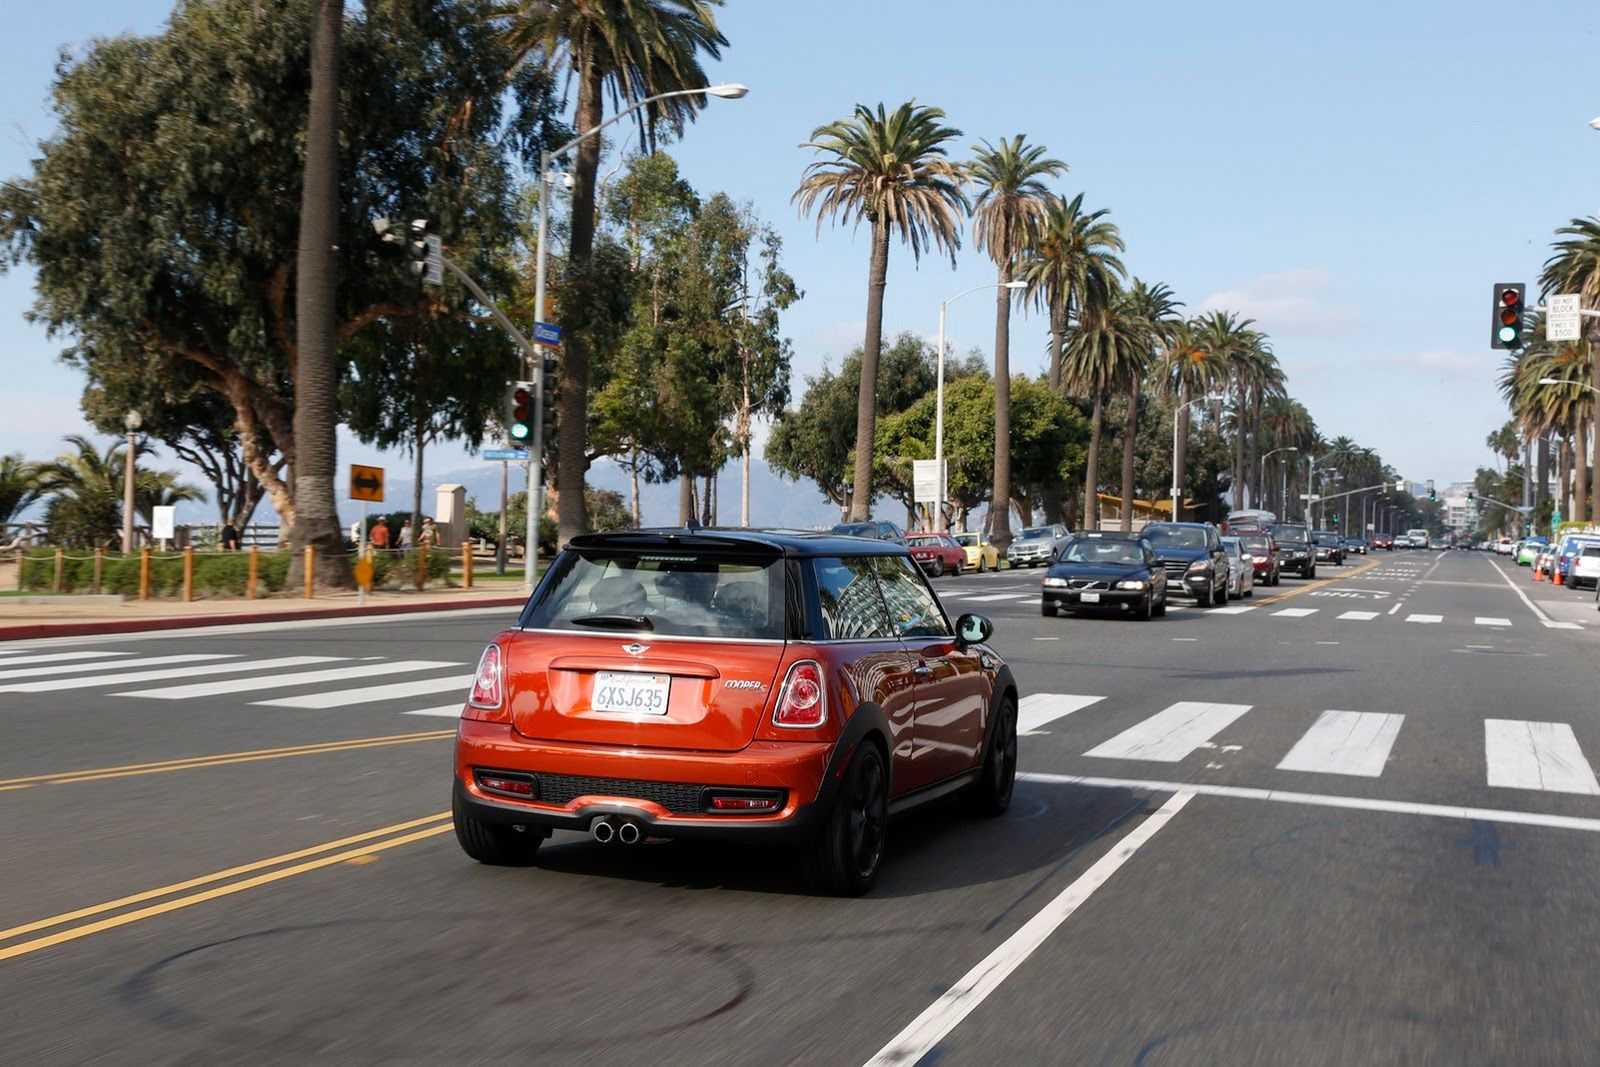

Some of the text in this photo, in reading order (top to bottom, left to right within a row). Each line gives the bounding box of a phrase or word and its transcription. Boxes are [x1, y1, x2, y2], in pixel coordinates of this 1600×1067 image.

[1552, 305, 1574, 313] BLOCK
[1554, 329, 1573, 337] $500
[724, 679, 761, 689] COOPER
[597, 686, 662, 708] 6XSJ635
